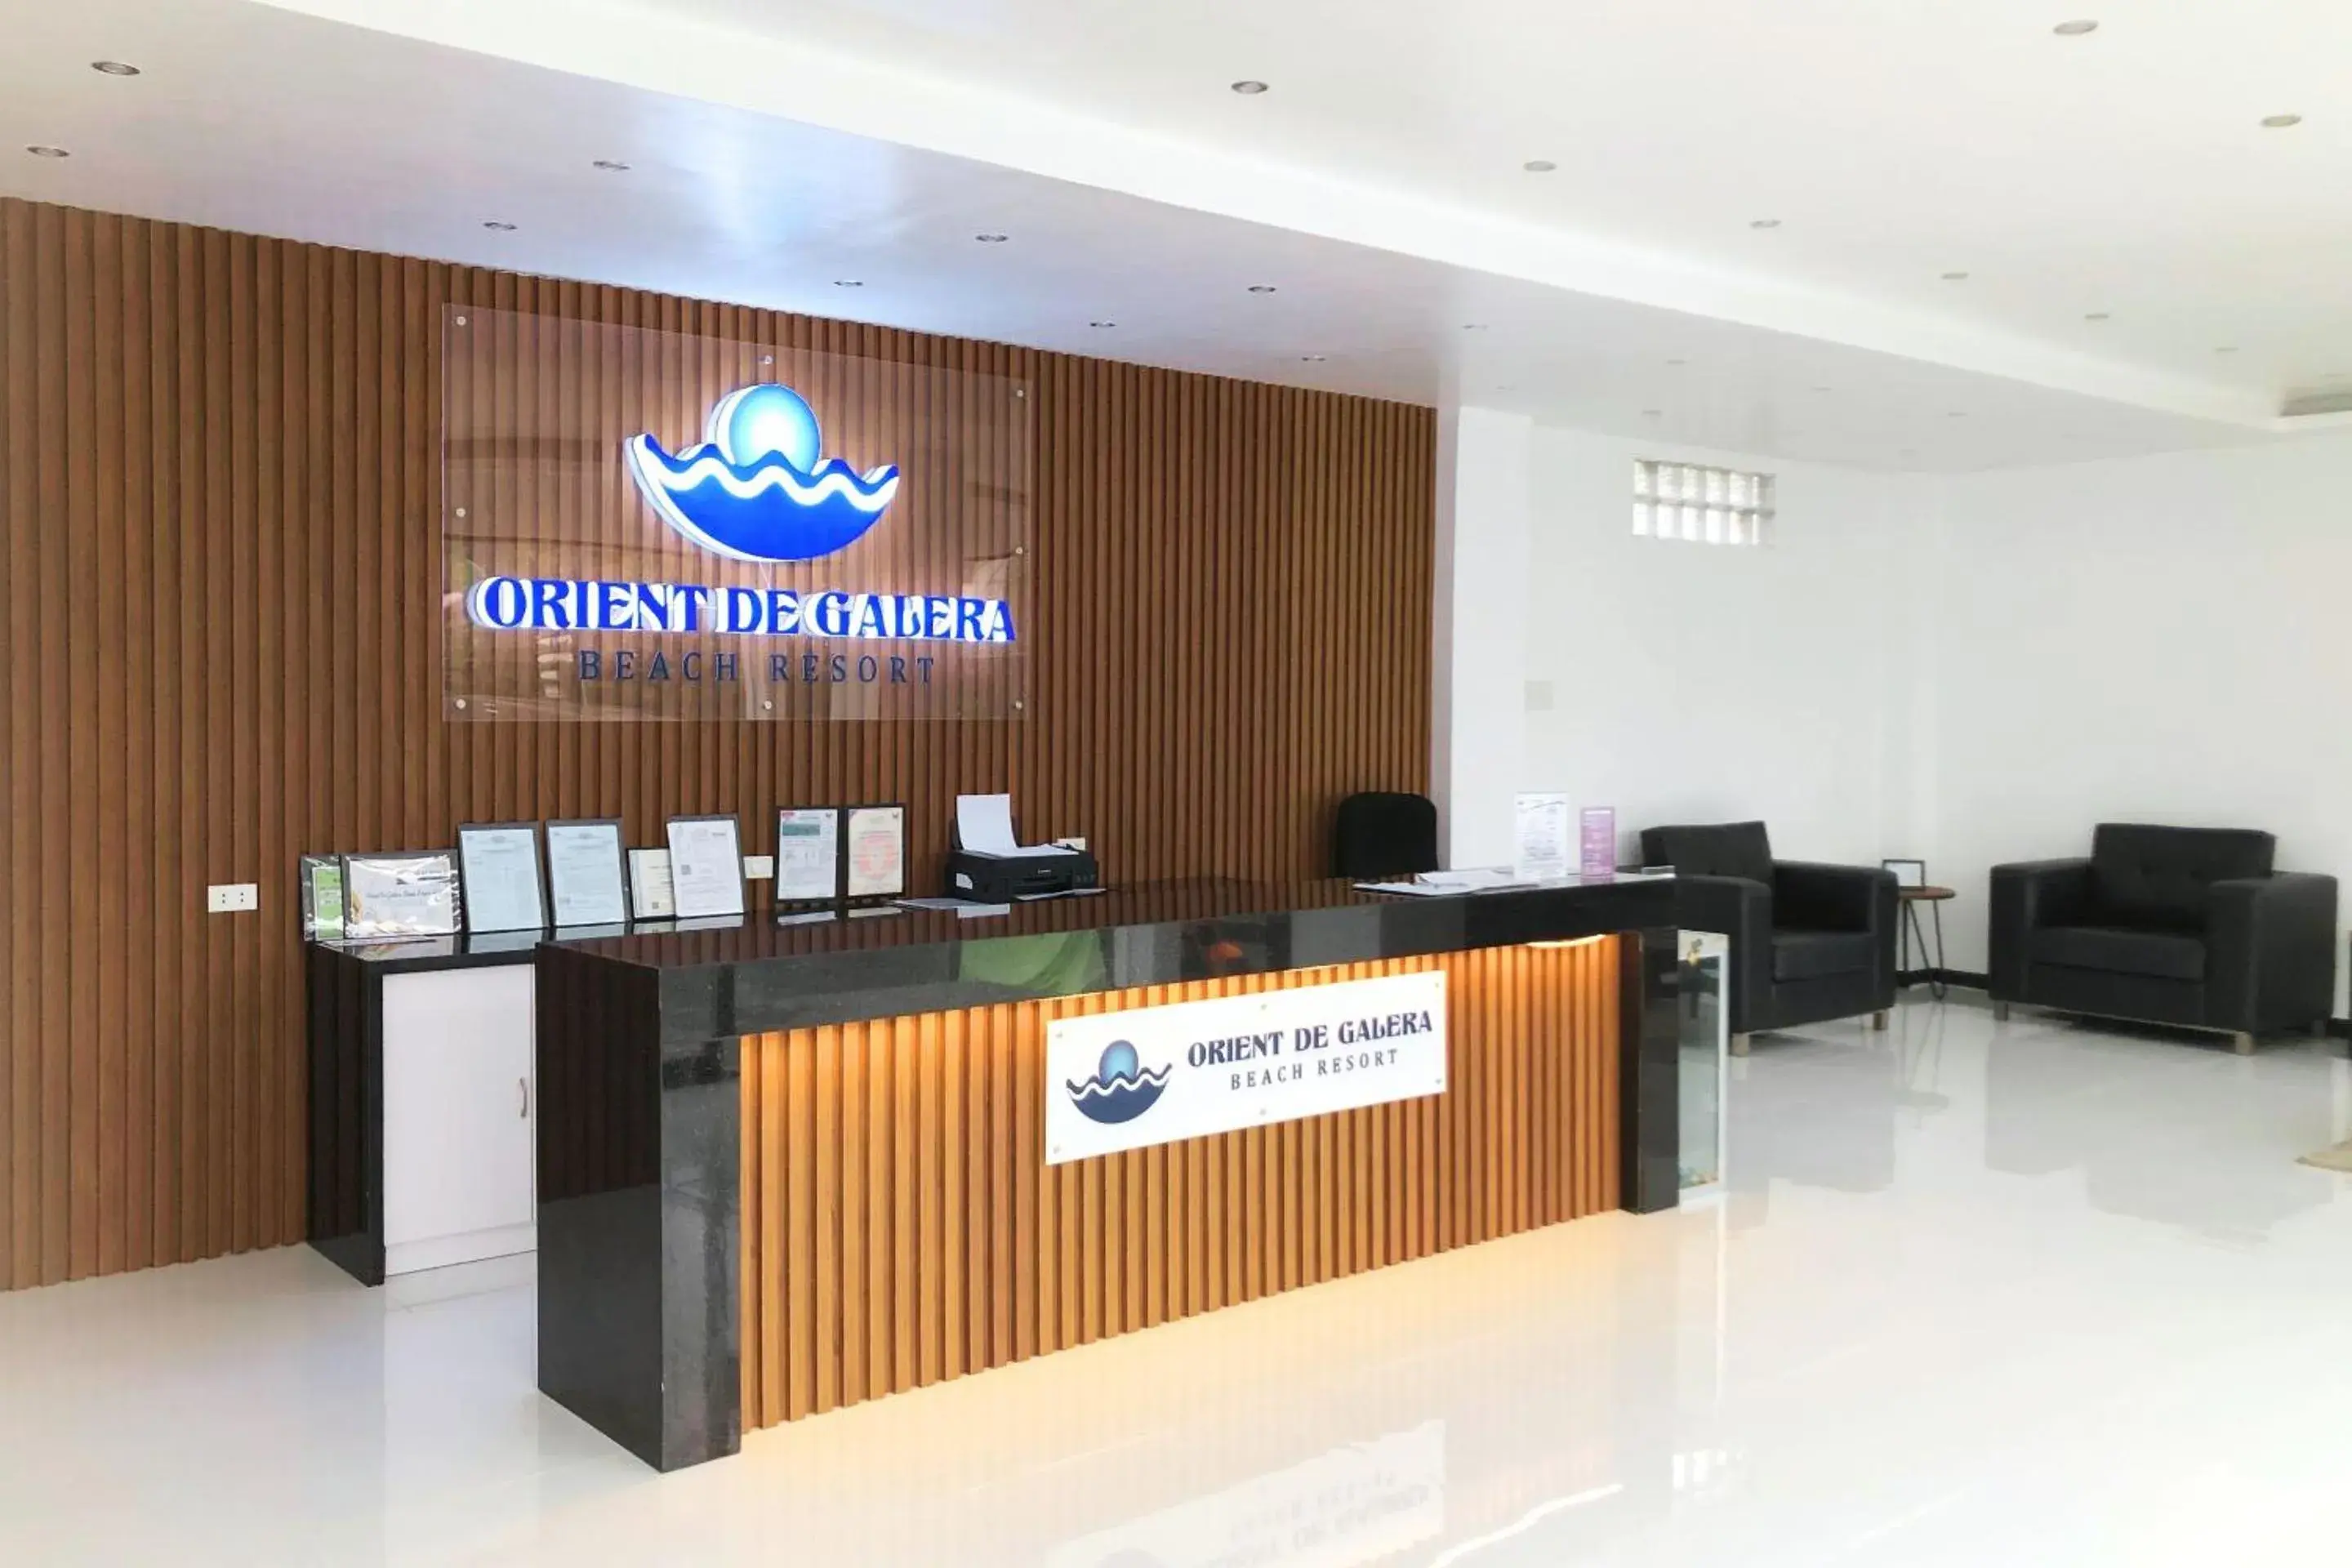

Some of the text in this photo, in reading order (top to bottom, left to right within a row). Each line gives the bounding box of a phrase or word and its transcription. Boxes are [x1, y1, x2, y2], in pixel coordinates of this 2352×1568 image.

[476, 575, 1016, 642] ORIENT DE GALERA
[578, 649, 935, 686] BEACH RESORT
[1187, 1010, 1432, 1067] ORIENT DE GALERA
[1231, 1049, 1397, 1090] BEACH RESORT
